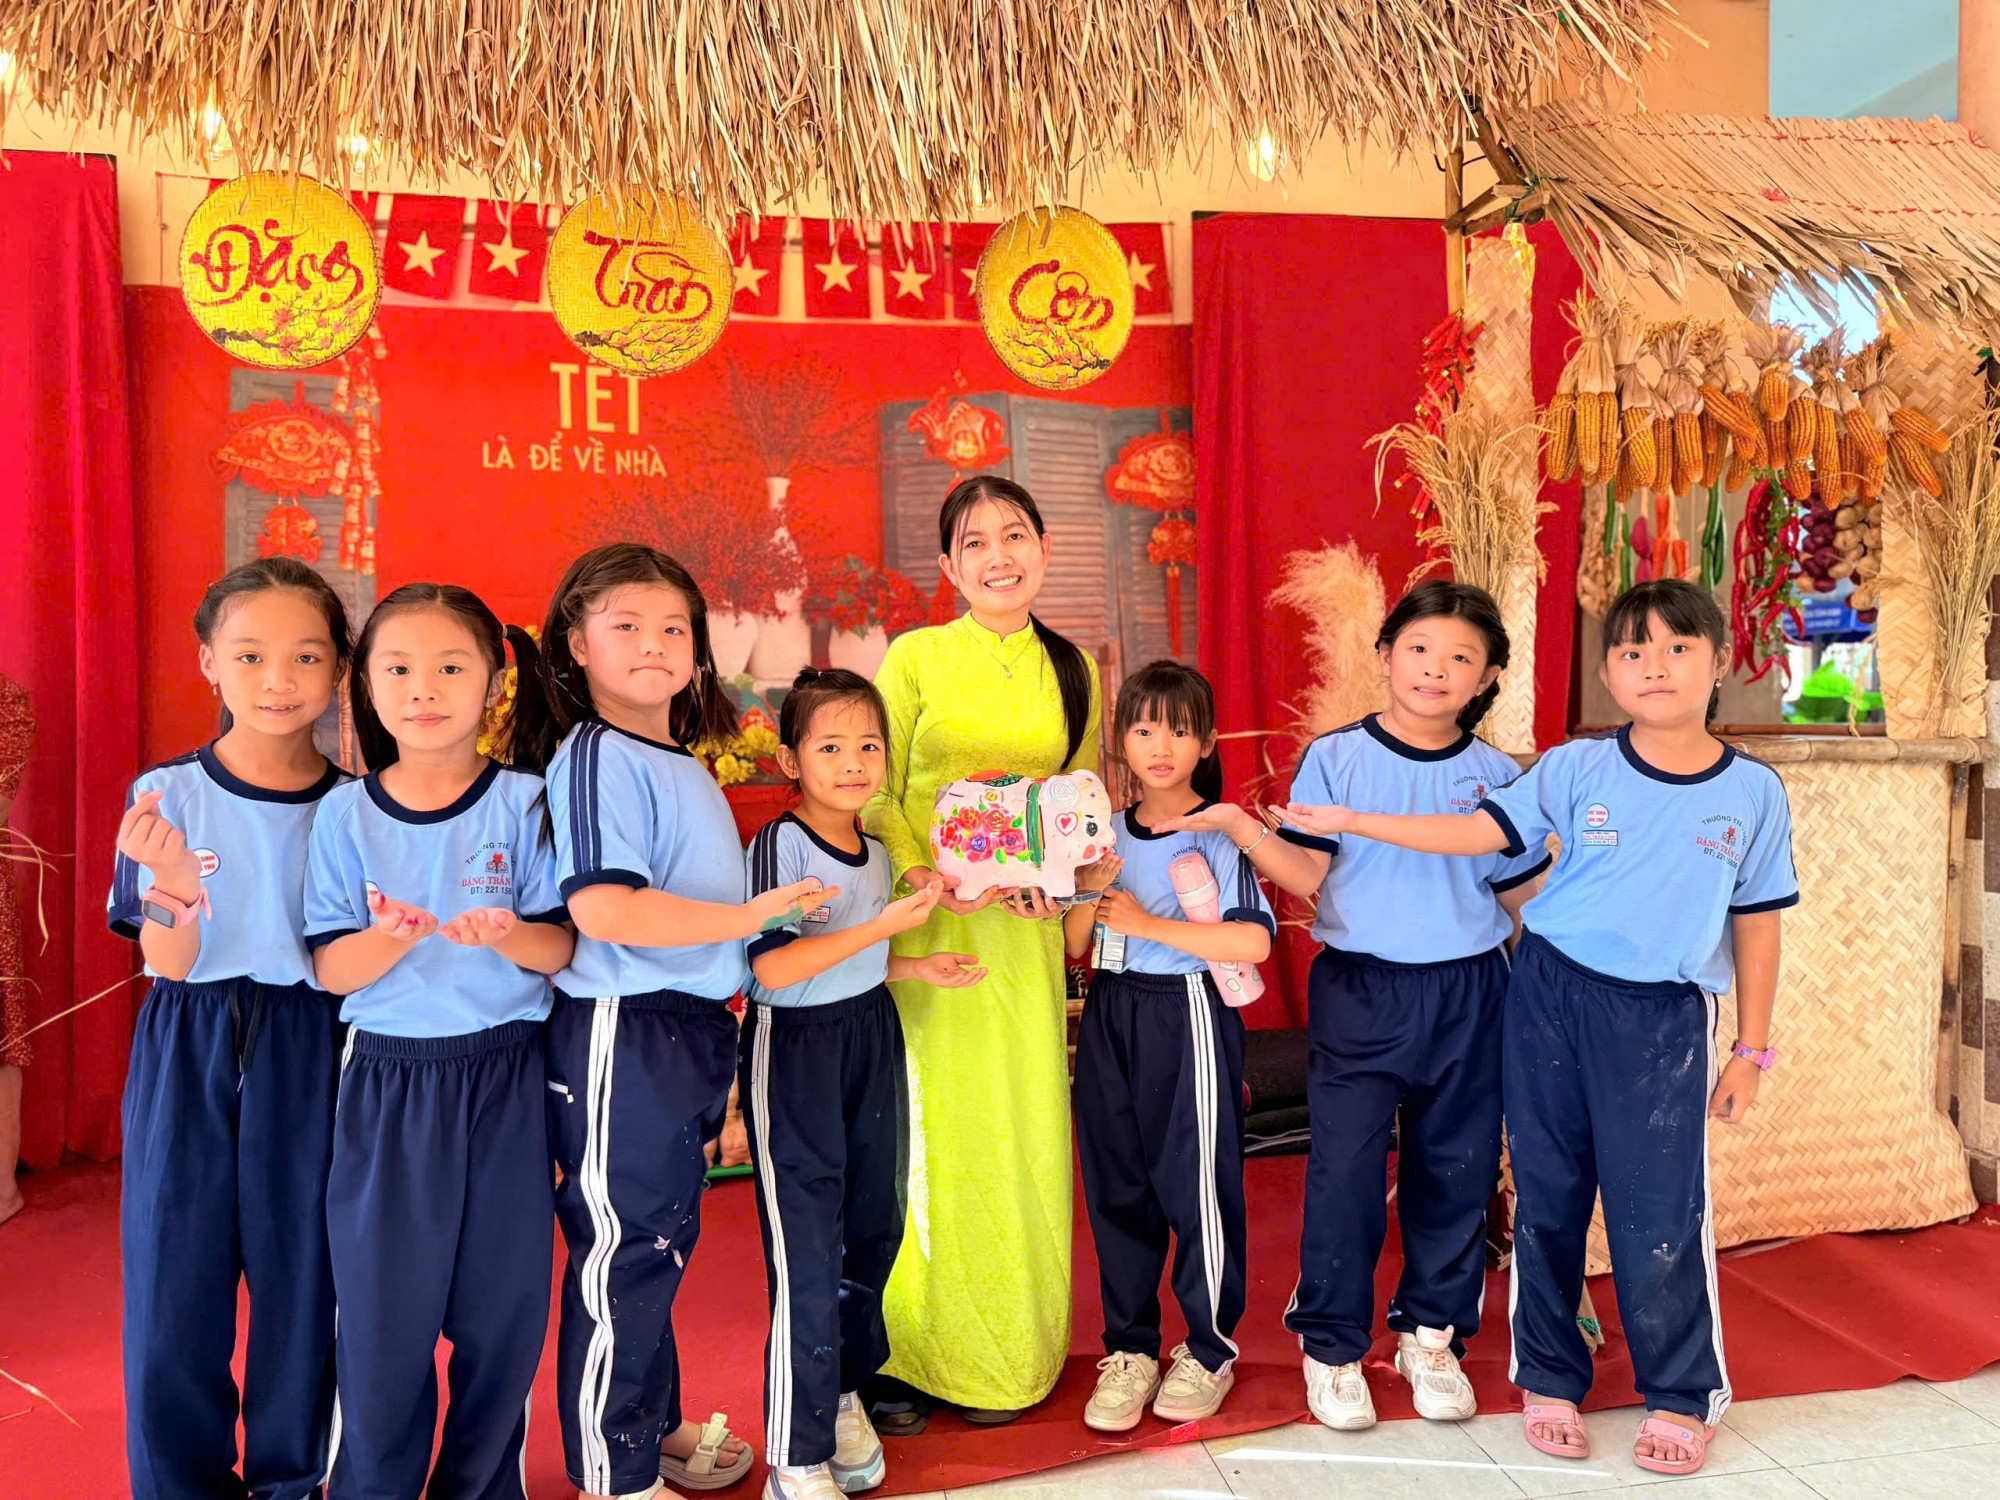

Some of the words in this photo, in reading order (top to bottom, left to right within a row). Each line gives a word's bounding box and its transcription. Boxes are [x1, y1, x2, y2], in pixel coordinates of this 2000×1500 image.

[482, 435, 515, 469] LÀ
[528, 430, 563, 472] ĐỂ
[573, 436, 607, 474] VỀ
[615, 444, 668, 477] NHÀ
[485, 885, 499, 894] 221
